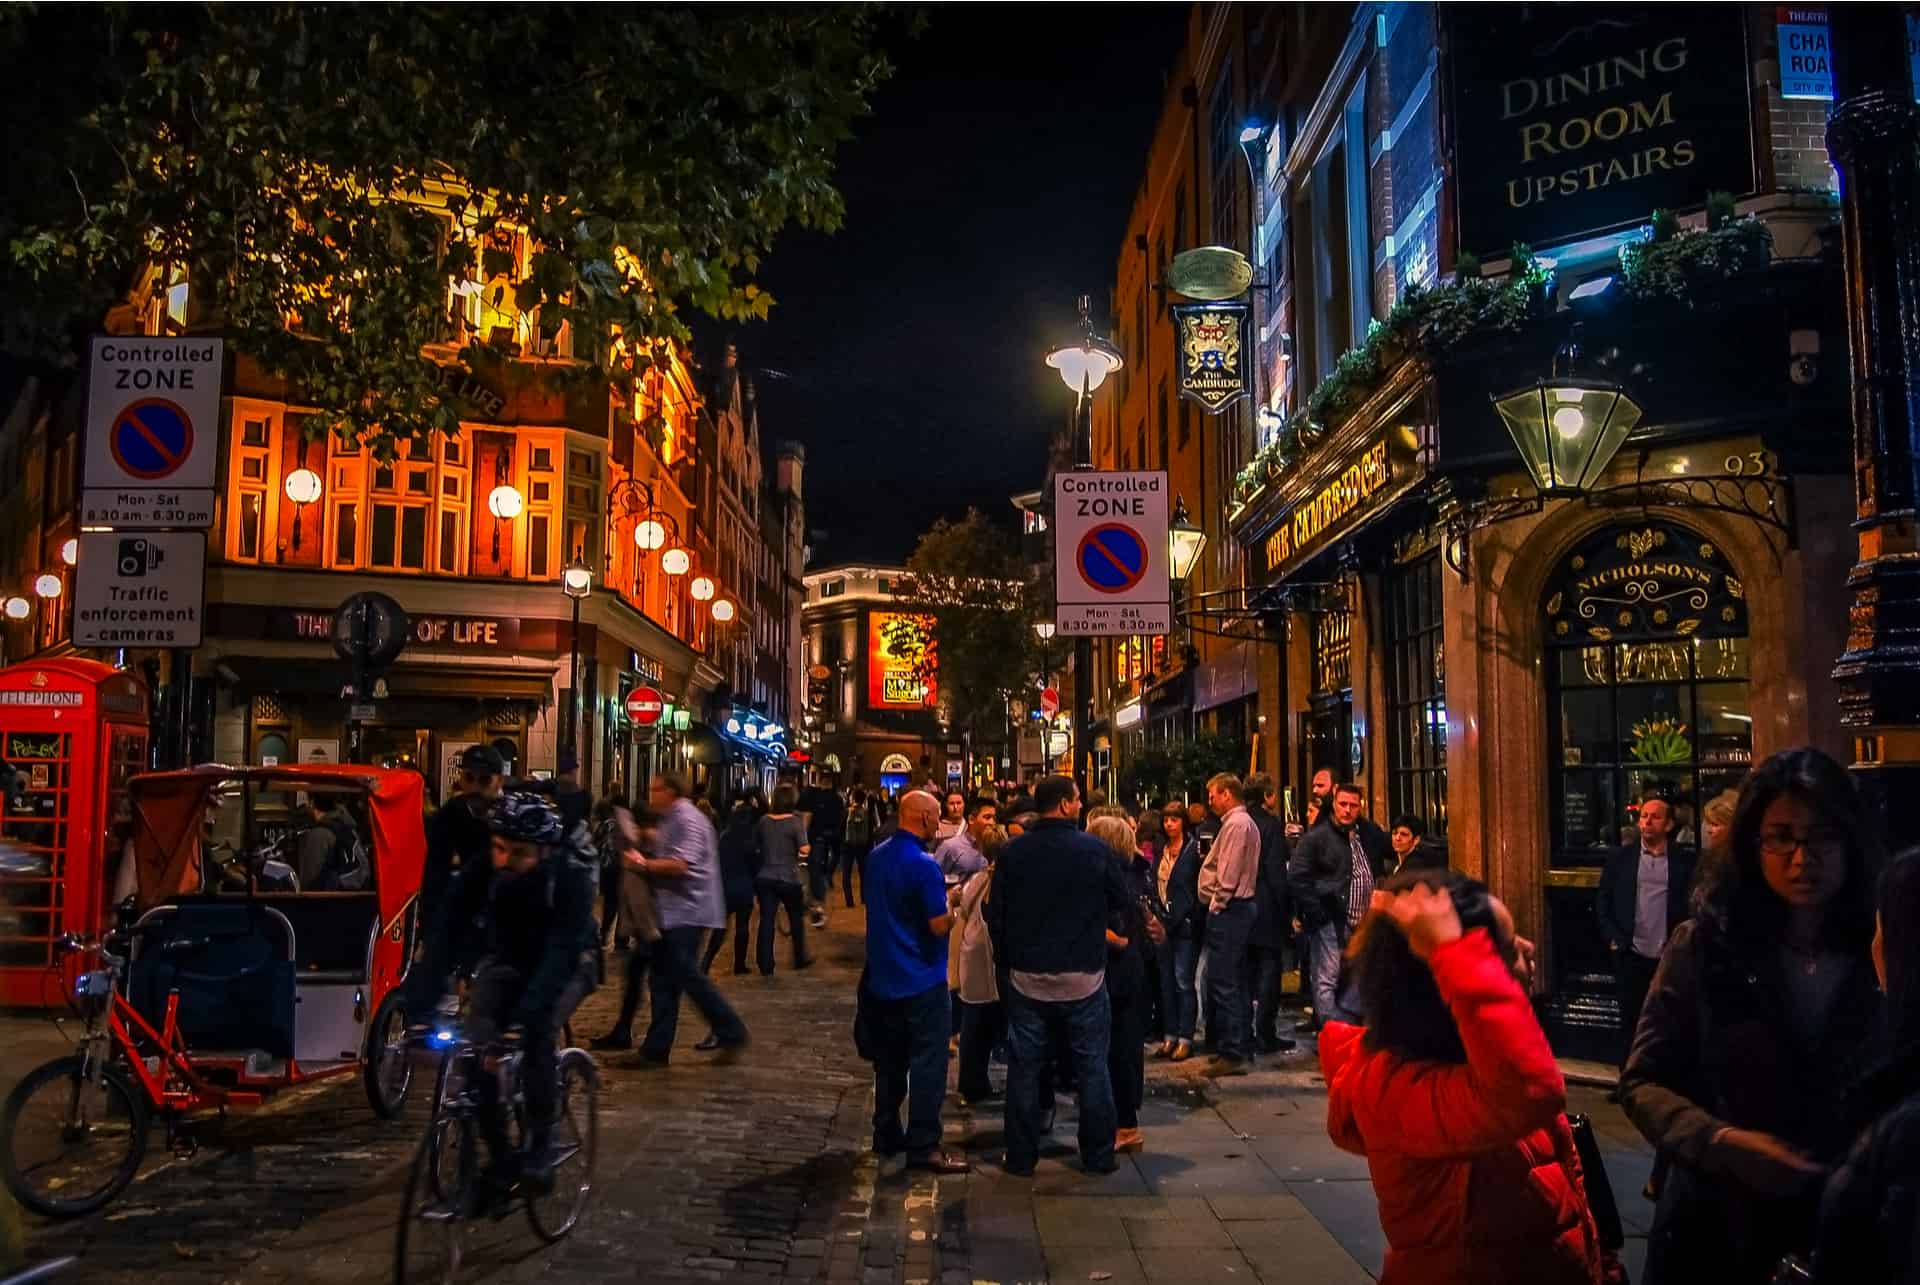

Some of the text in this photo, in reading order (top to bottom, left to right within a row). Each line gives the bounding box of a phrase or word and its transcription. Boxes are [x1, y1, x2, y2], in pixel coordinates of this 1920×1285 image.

[1789, 32, 1828, 51] CHA
[1791, 56, 1829, 73] ROA
[1499, 37, 1689, 120] DINING
[1519, 91, 1677, 164] ROOM
[1505, 139, 1697, 209] UPSTAIRS
[101, 344, 214, 362] Controlled
[115, 368, 194, 389] ZONE
[1202, 370, 1222, 379] THE
[1183, 378, 1241, 389] CAMBRIDGE
[1724, 451, 1765, 477] 93
[1062, 476, 1160, 492] Controlled
[117, 494, 145, 505] Mon
[155, 494, 179, 505] Sat
[1077, 498, 1145, 516] ZONE
[1266, 440, 1388, 571] THE CAMBRIDGE
[121, 512, 141, 521] am
[188, 511, 208, 524] pm
[1577, 563, 1712, 594] NICHOLSON'S
[109, 586, 169, 601] Traffic
[80, 608, 194, 622] enforcement
[1086, 608, 1110, 619] Mon
[1121, 608, 1141, 618] Sat
[99, 629, 175, 642] cameras
[416, 618, 448, 642] OF
[451, 620, 499, 644] LIFE
[1091, 622, 1107, 632] am
[1148, 622, 1165, 632] pm
